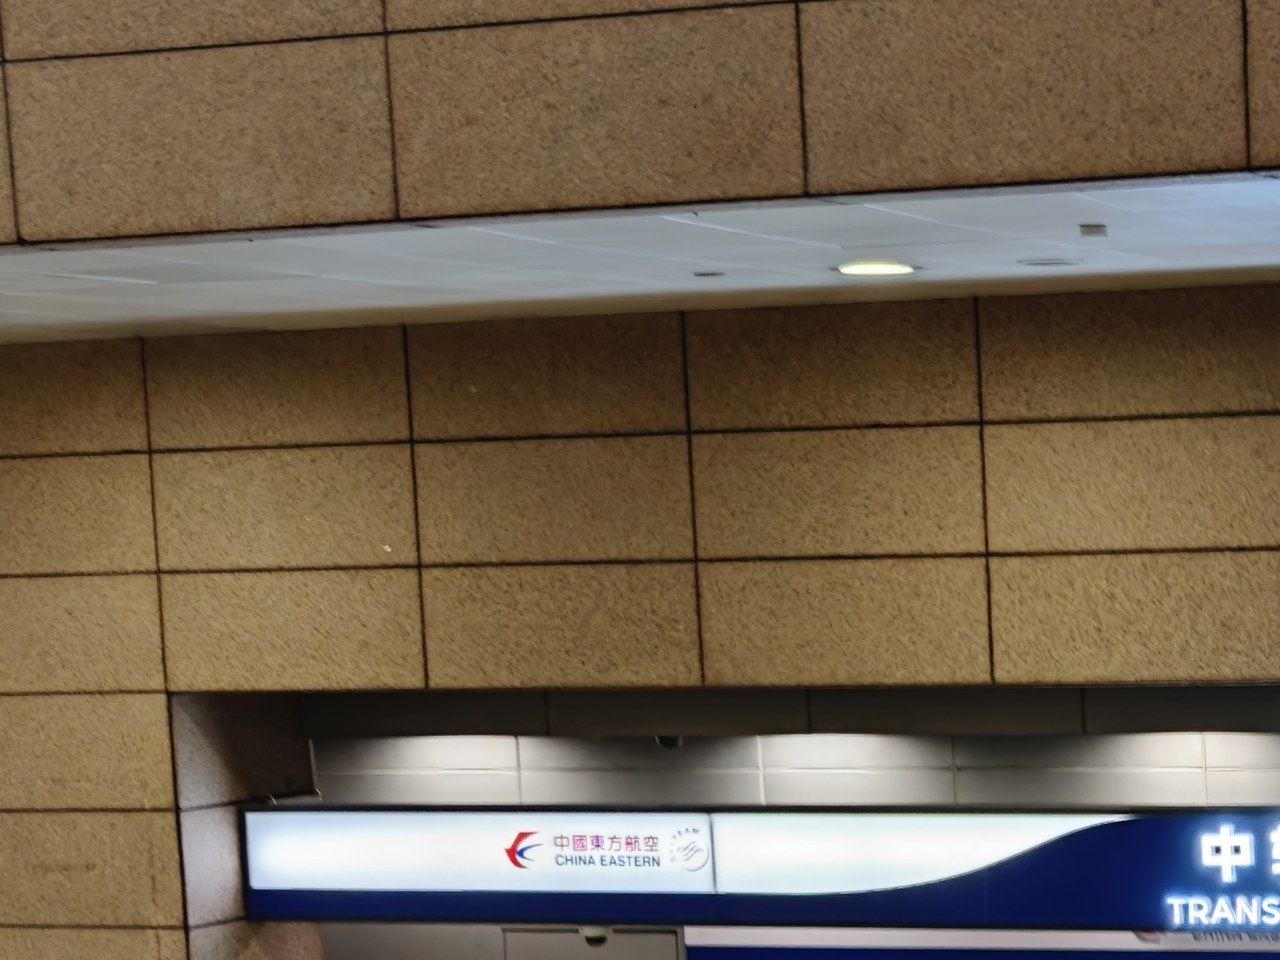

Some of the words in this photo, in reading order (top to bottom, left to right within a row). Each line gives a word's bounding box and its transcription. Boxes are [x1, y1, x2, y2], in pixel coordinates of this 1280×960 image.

[553, 834, 660, 853] 中國東方航空
[555, 854, 596, 867] CHINA
[600, 855, 661, 868] EASTERN
